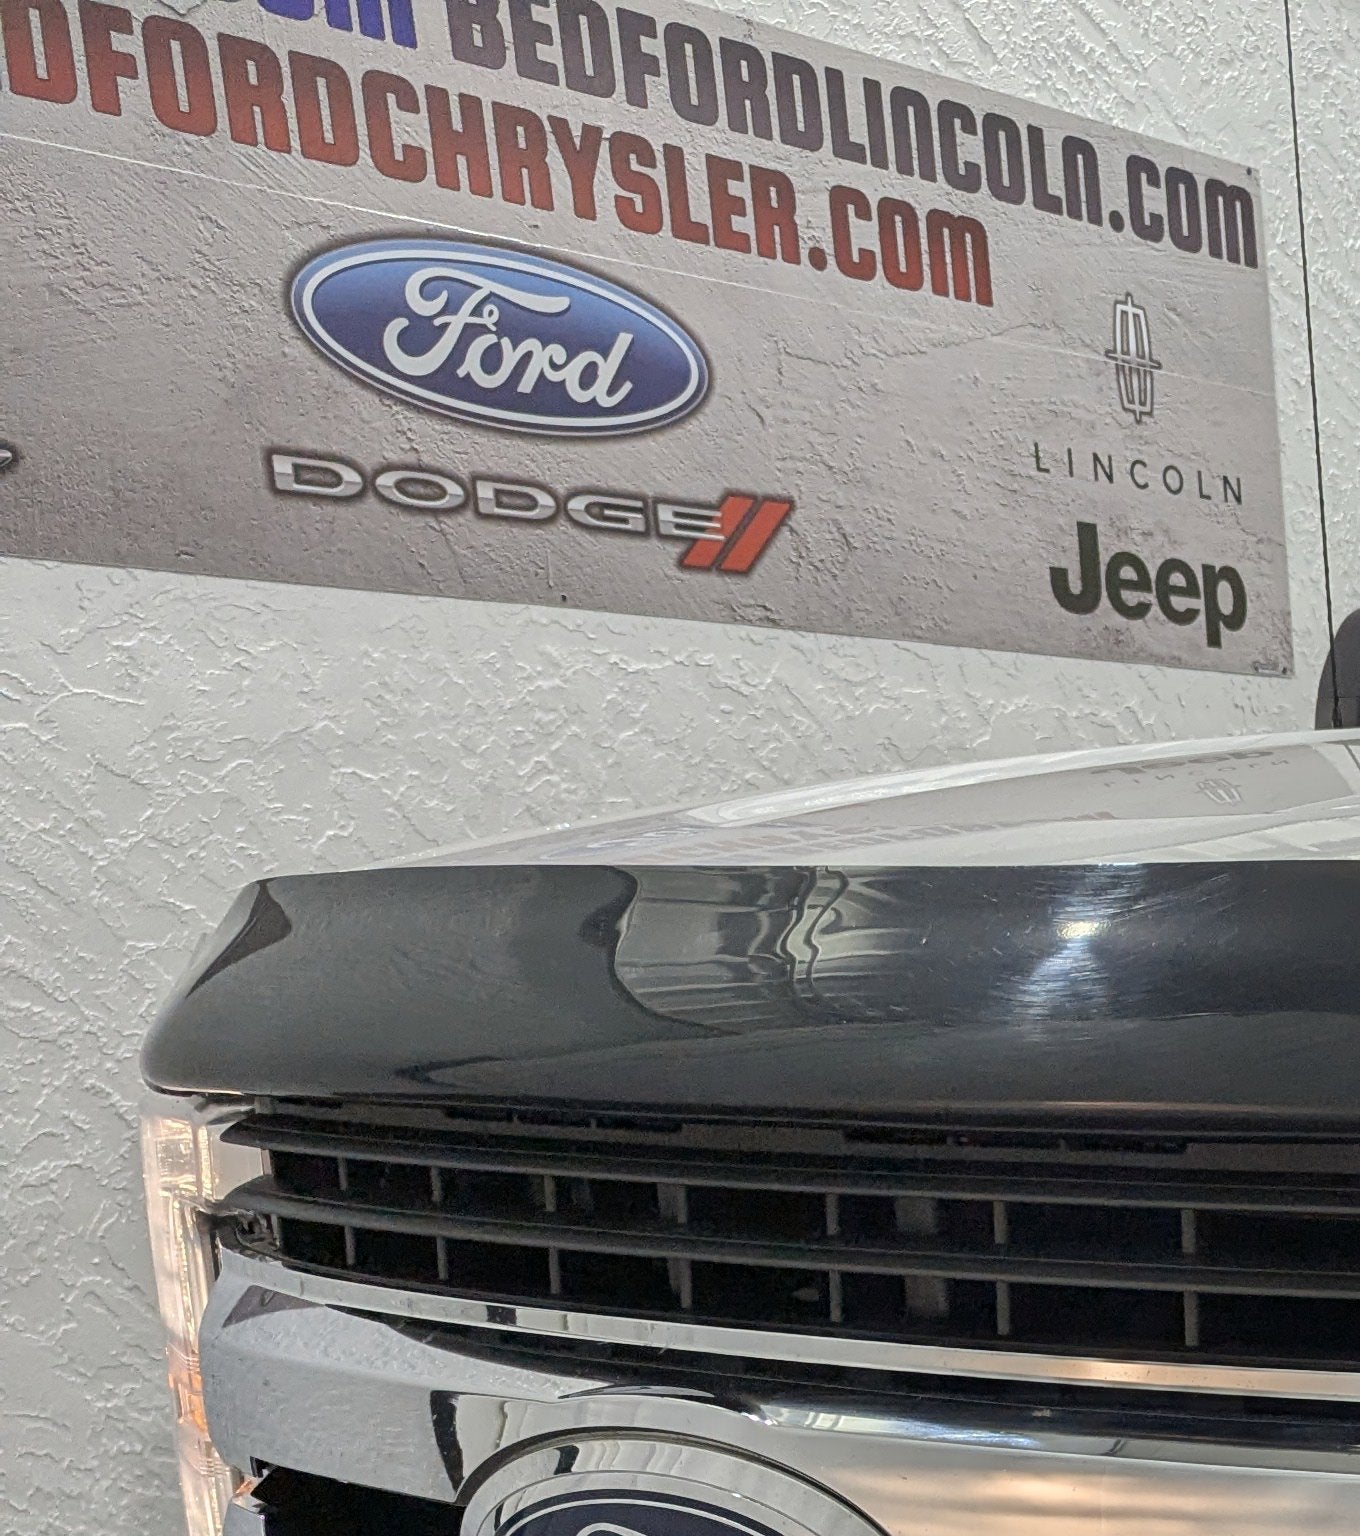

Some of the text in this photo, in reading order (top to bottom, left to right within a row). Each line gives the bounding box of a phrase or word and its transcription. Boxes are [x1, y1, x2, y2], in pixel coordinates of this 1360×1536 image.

[383, 267, 635, 408] Ford
[271, 453, 726, 545] DODGE
[1034, 442, 1244, 506] LINCOLN
[1049, 521, 1248, 648] Jeep
